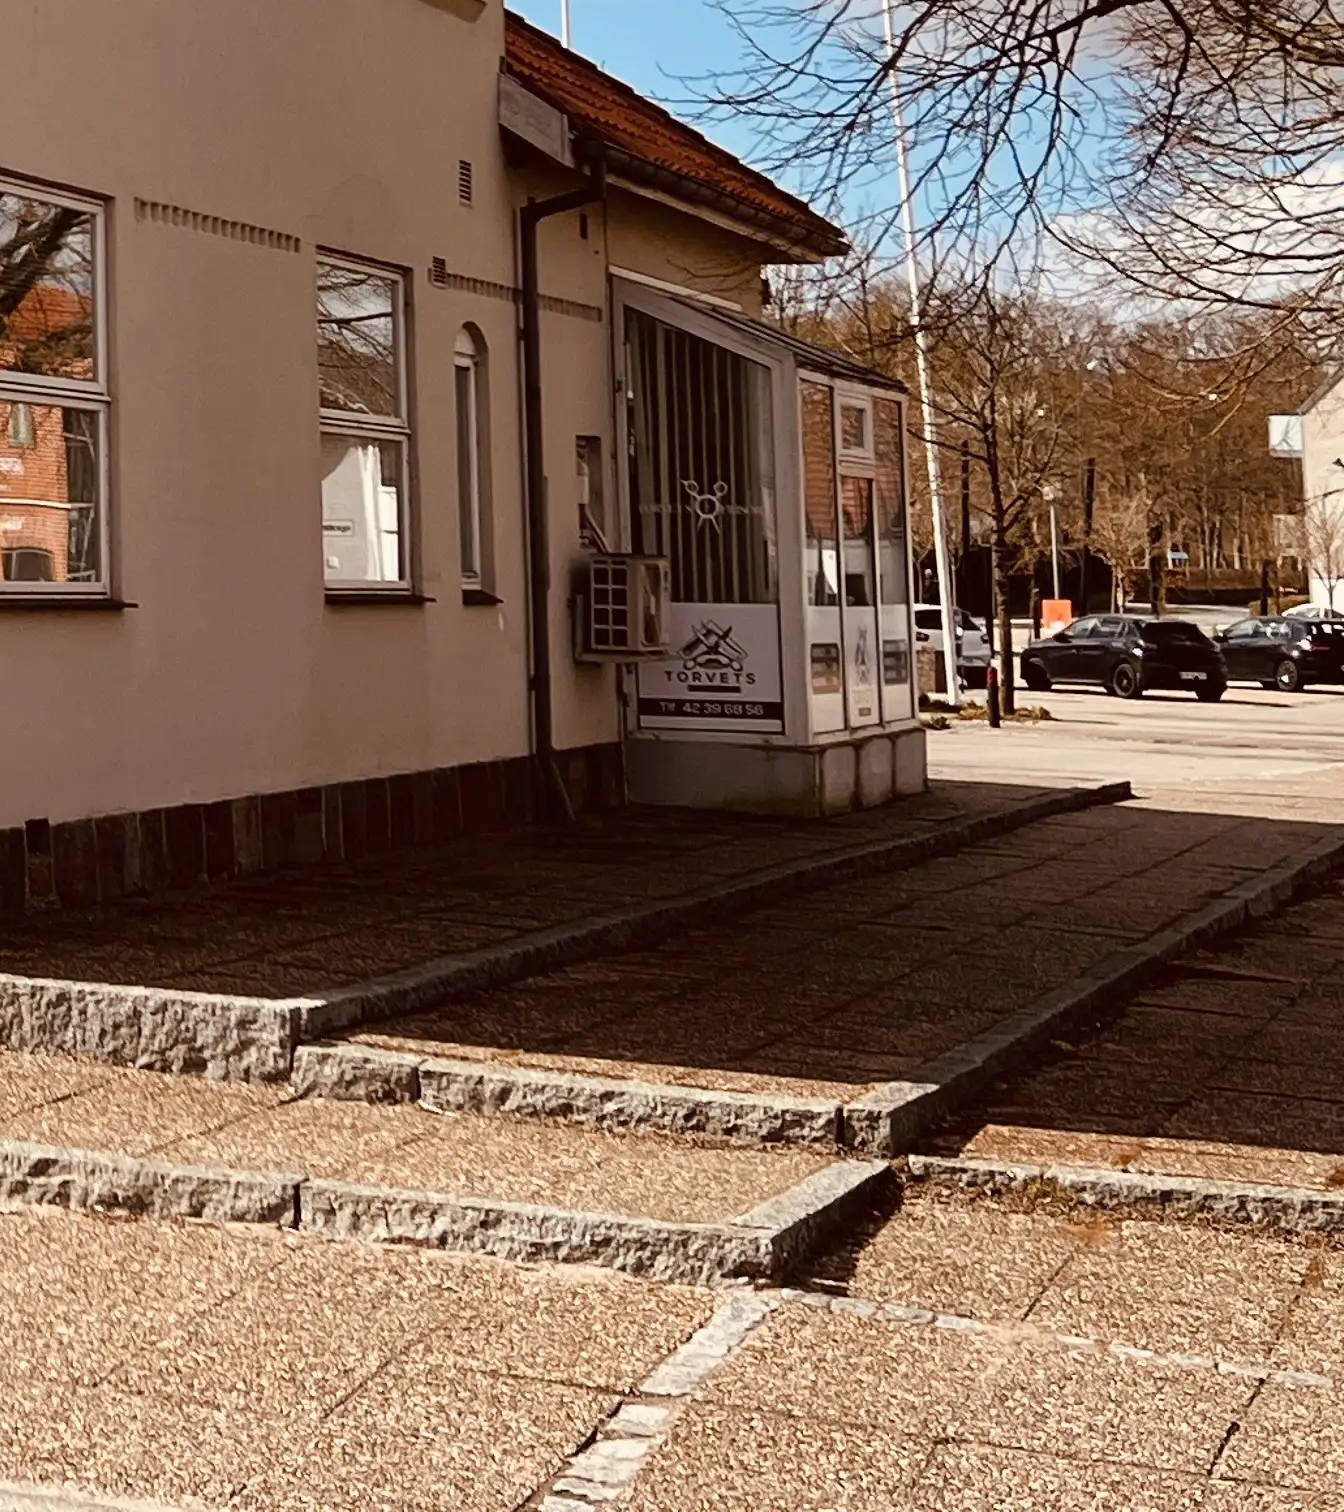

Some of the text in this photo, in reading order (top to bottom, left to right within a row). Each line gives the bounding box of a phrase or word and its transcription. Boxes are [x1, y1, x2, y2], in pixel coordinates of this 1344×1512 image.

[664, 670, 756, 685] TORVETS
[682, 702, 700, 714] 42
[703, 703, 721, 715] 39
